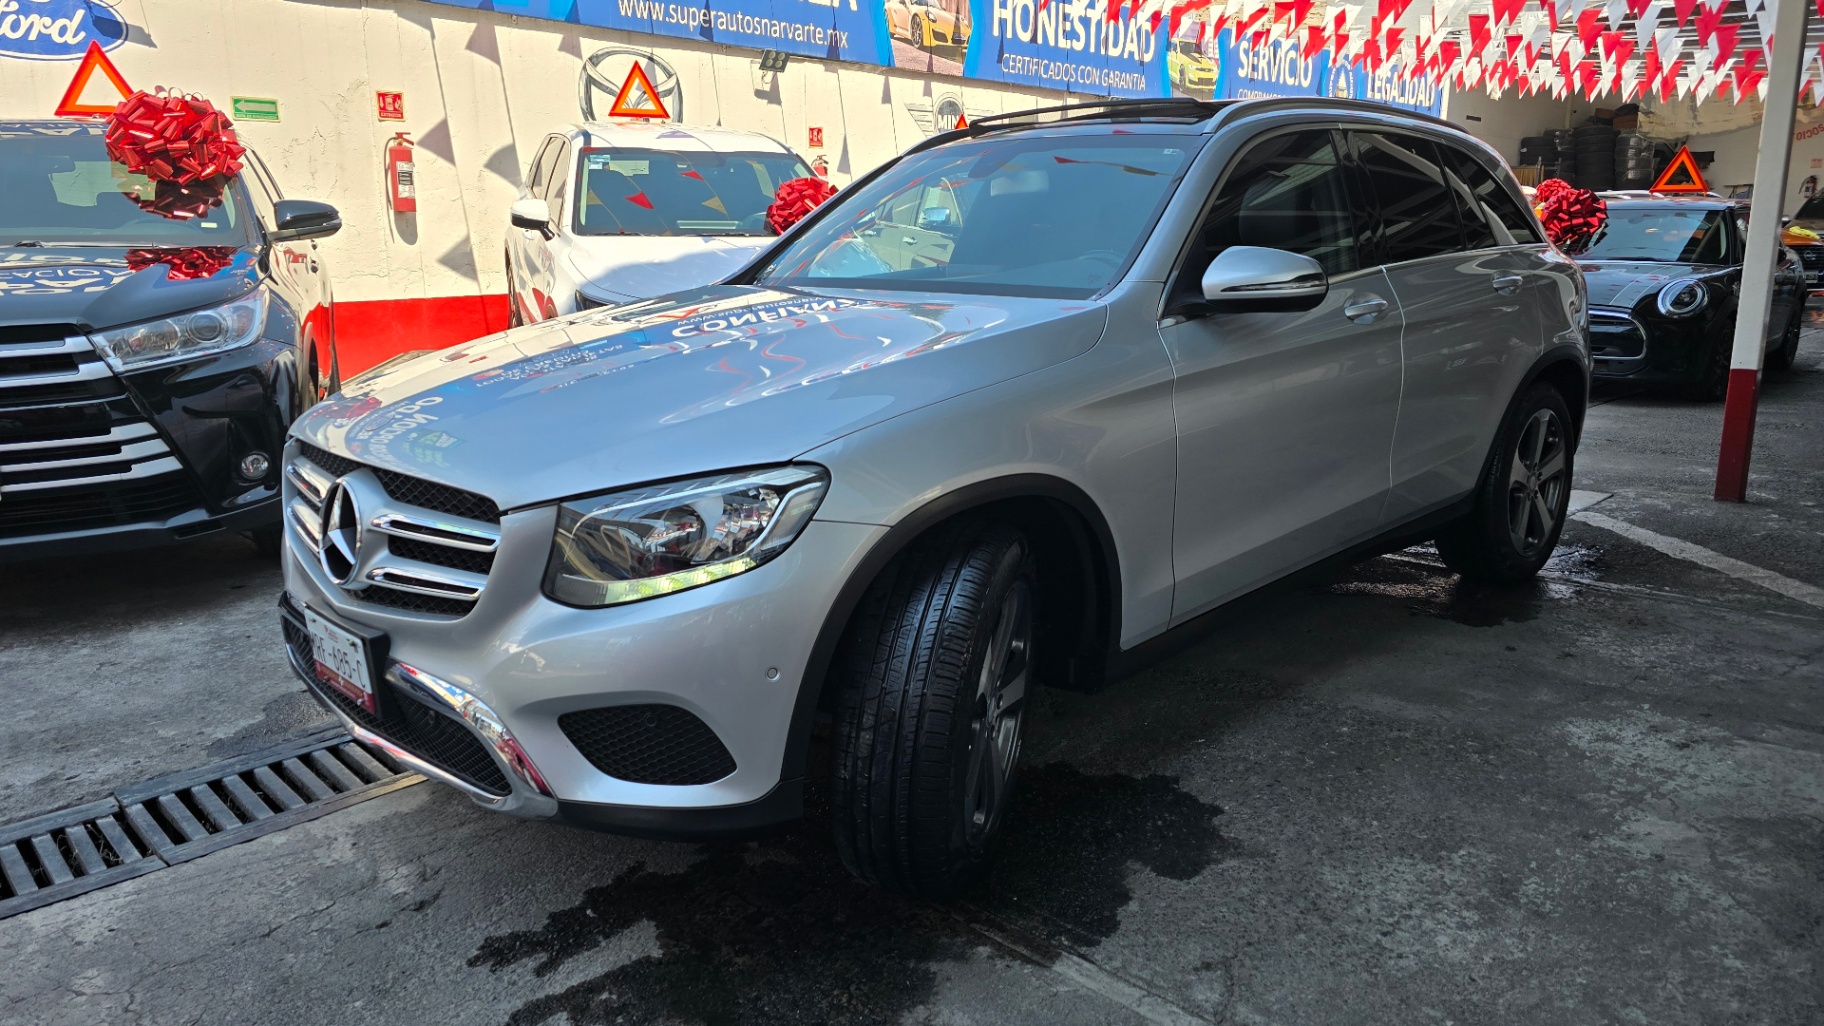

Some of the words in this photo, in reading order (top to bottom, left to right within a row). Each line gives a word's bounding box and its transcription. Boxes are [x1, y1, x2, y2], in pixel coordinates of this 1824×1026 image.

[618, 0, 848, 48] www.superautosnarvarte.mx
[993, 0, 1155, 62] HONESTIDAD
[1002, 54, 1076, 82] CERTIFICADOS
[1078, 65, 1100, 85] CON
[1101, 69, 1146, 92] GARANTIA
[1238, 40, 1312, 88] SERVICIO
[1367, 66, 1435, 107] LEGALIDAD
